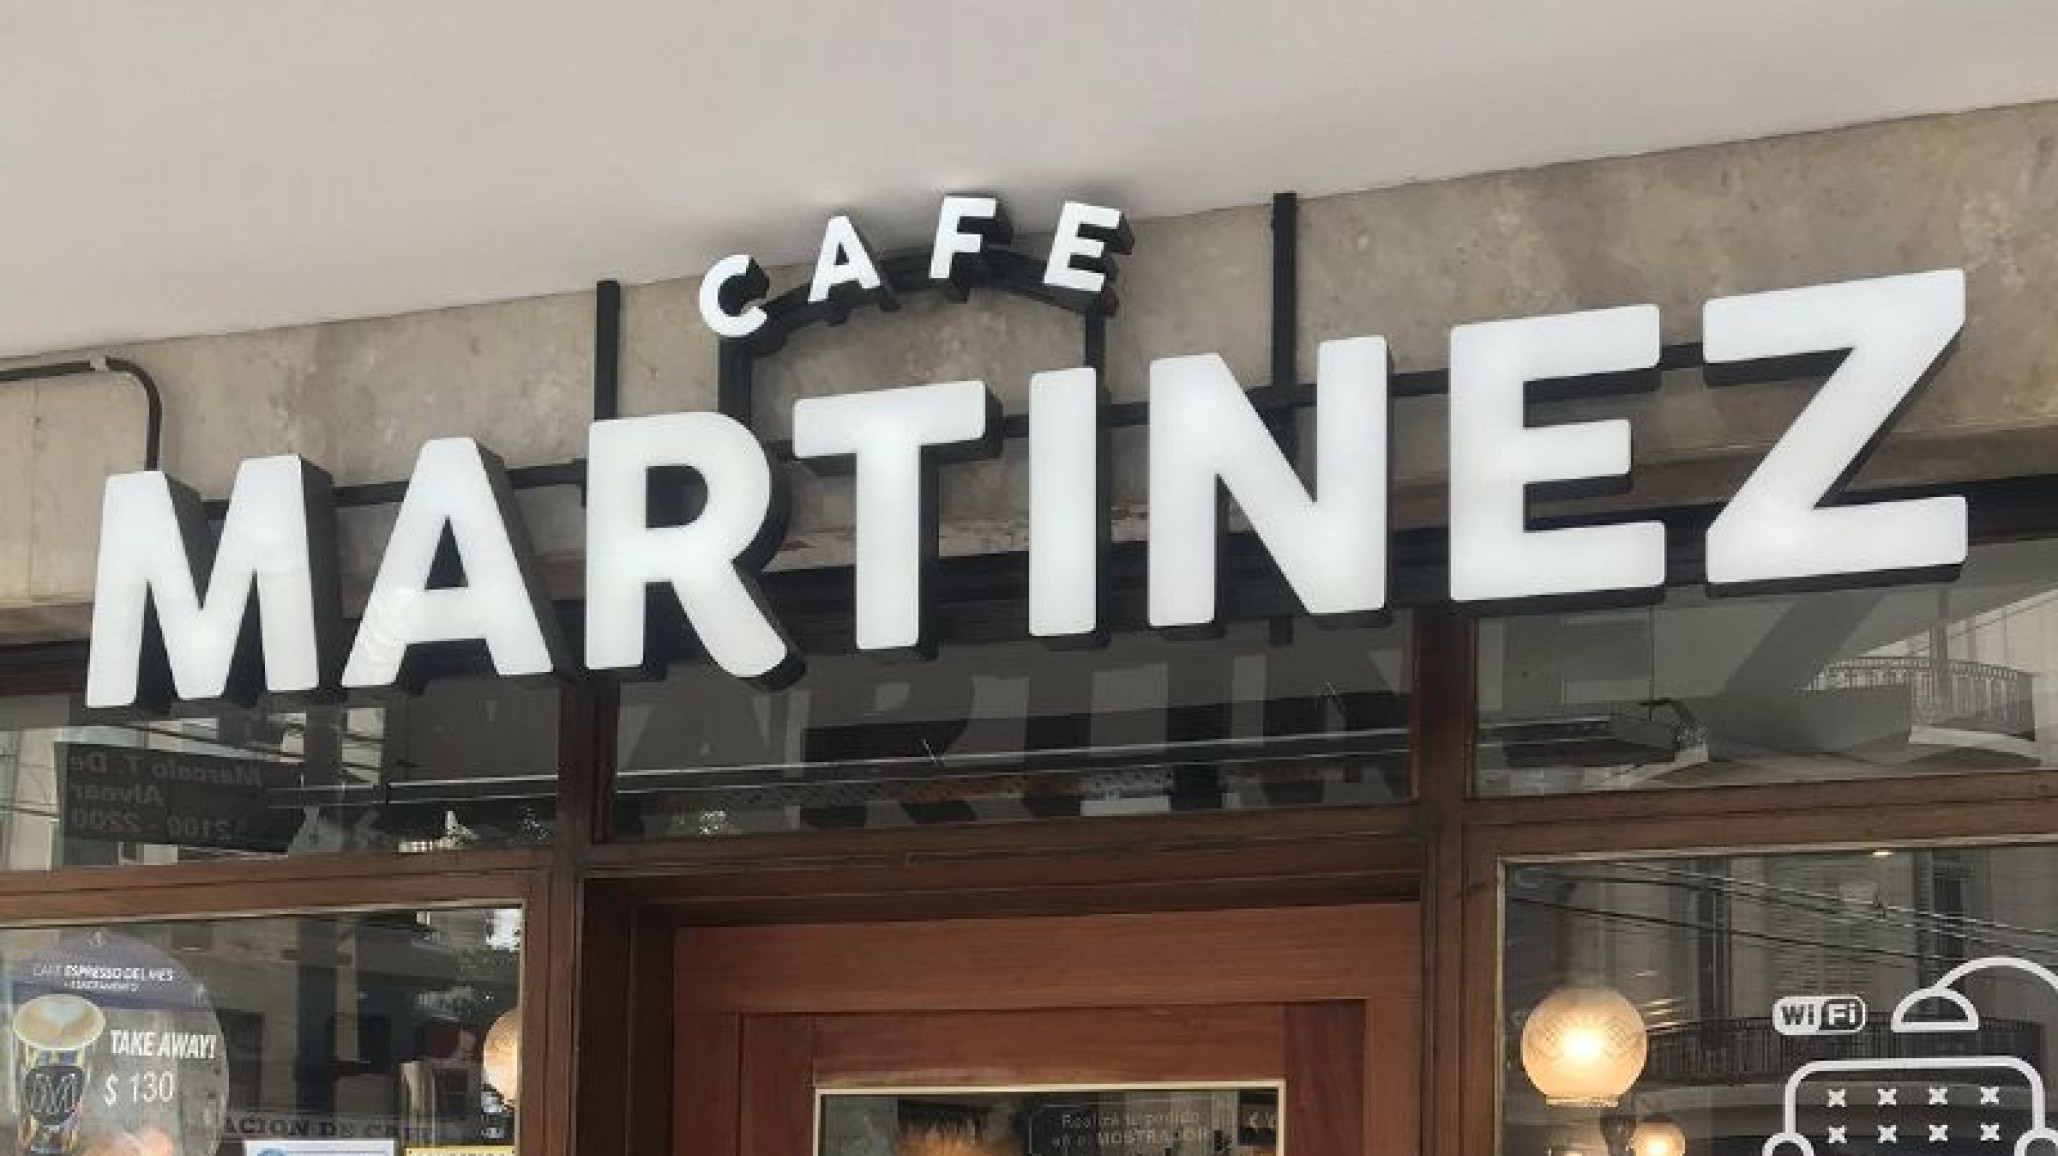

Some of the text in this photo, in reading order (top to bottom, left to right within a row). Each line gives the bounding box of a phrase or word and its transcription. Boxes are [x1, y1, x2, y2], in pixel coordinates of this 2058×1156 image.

[700, 197, 1121, 338] CAFE
[86, 268, 1967, 710] MARTINEZ
[110, 1029, 217, 1059] TAKE AWAY!
[103, 1070, 175, 1108] $ 130
